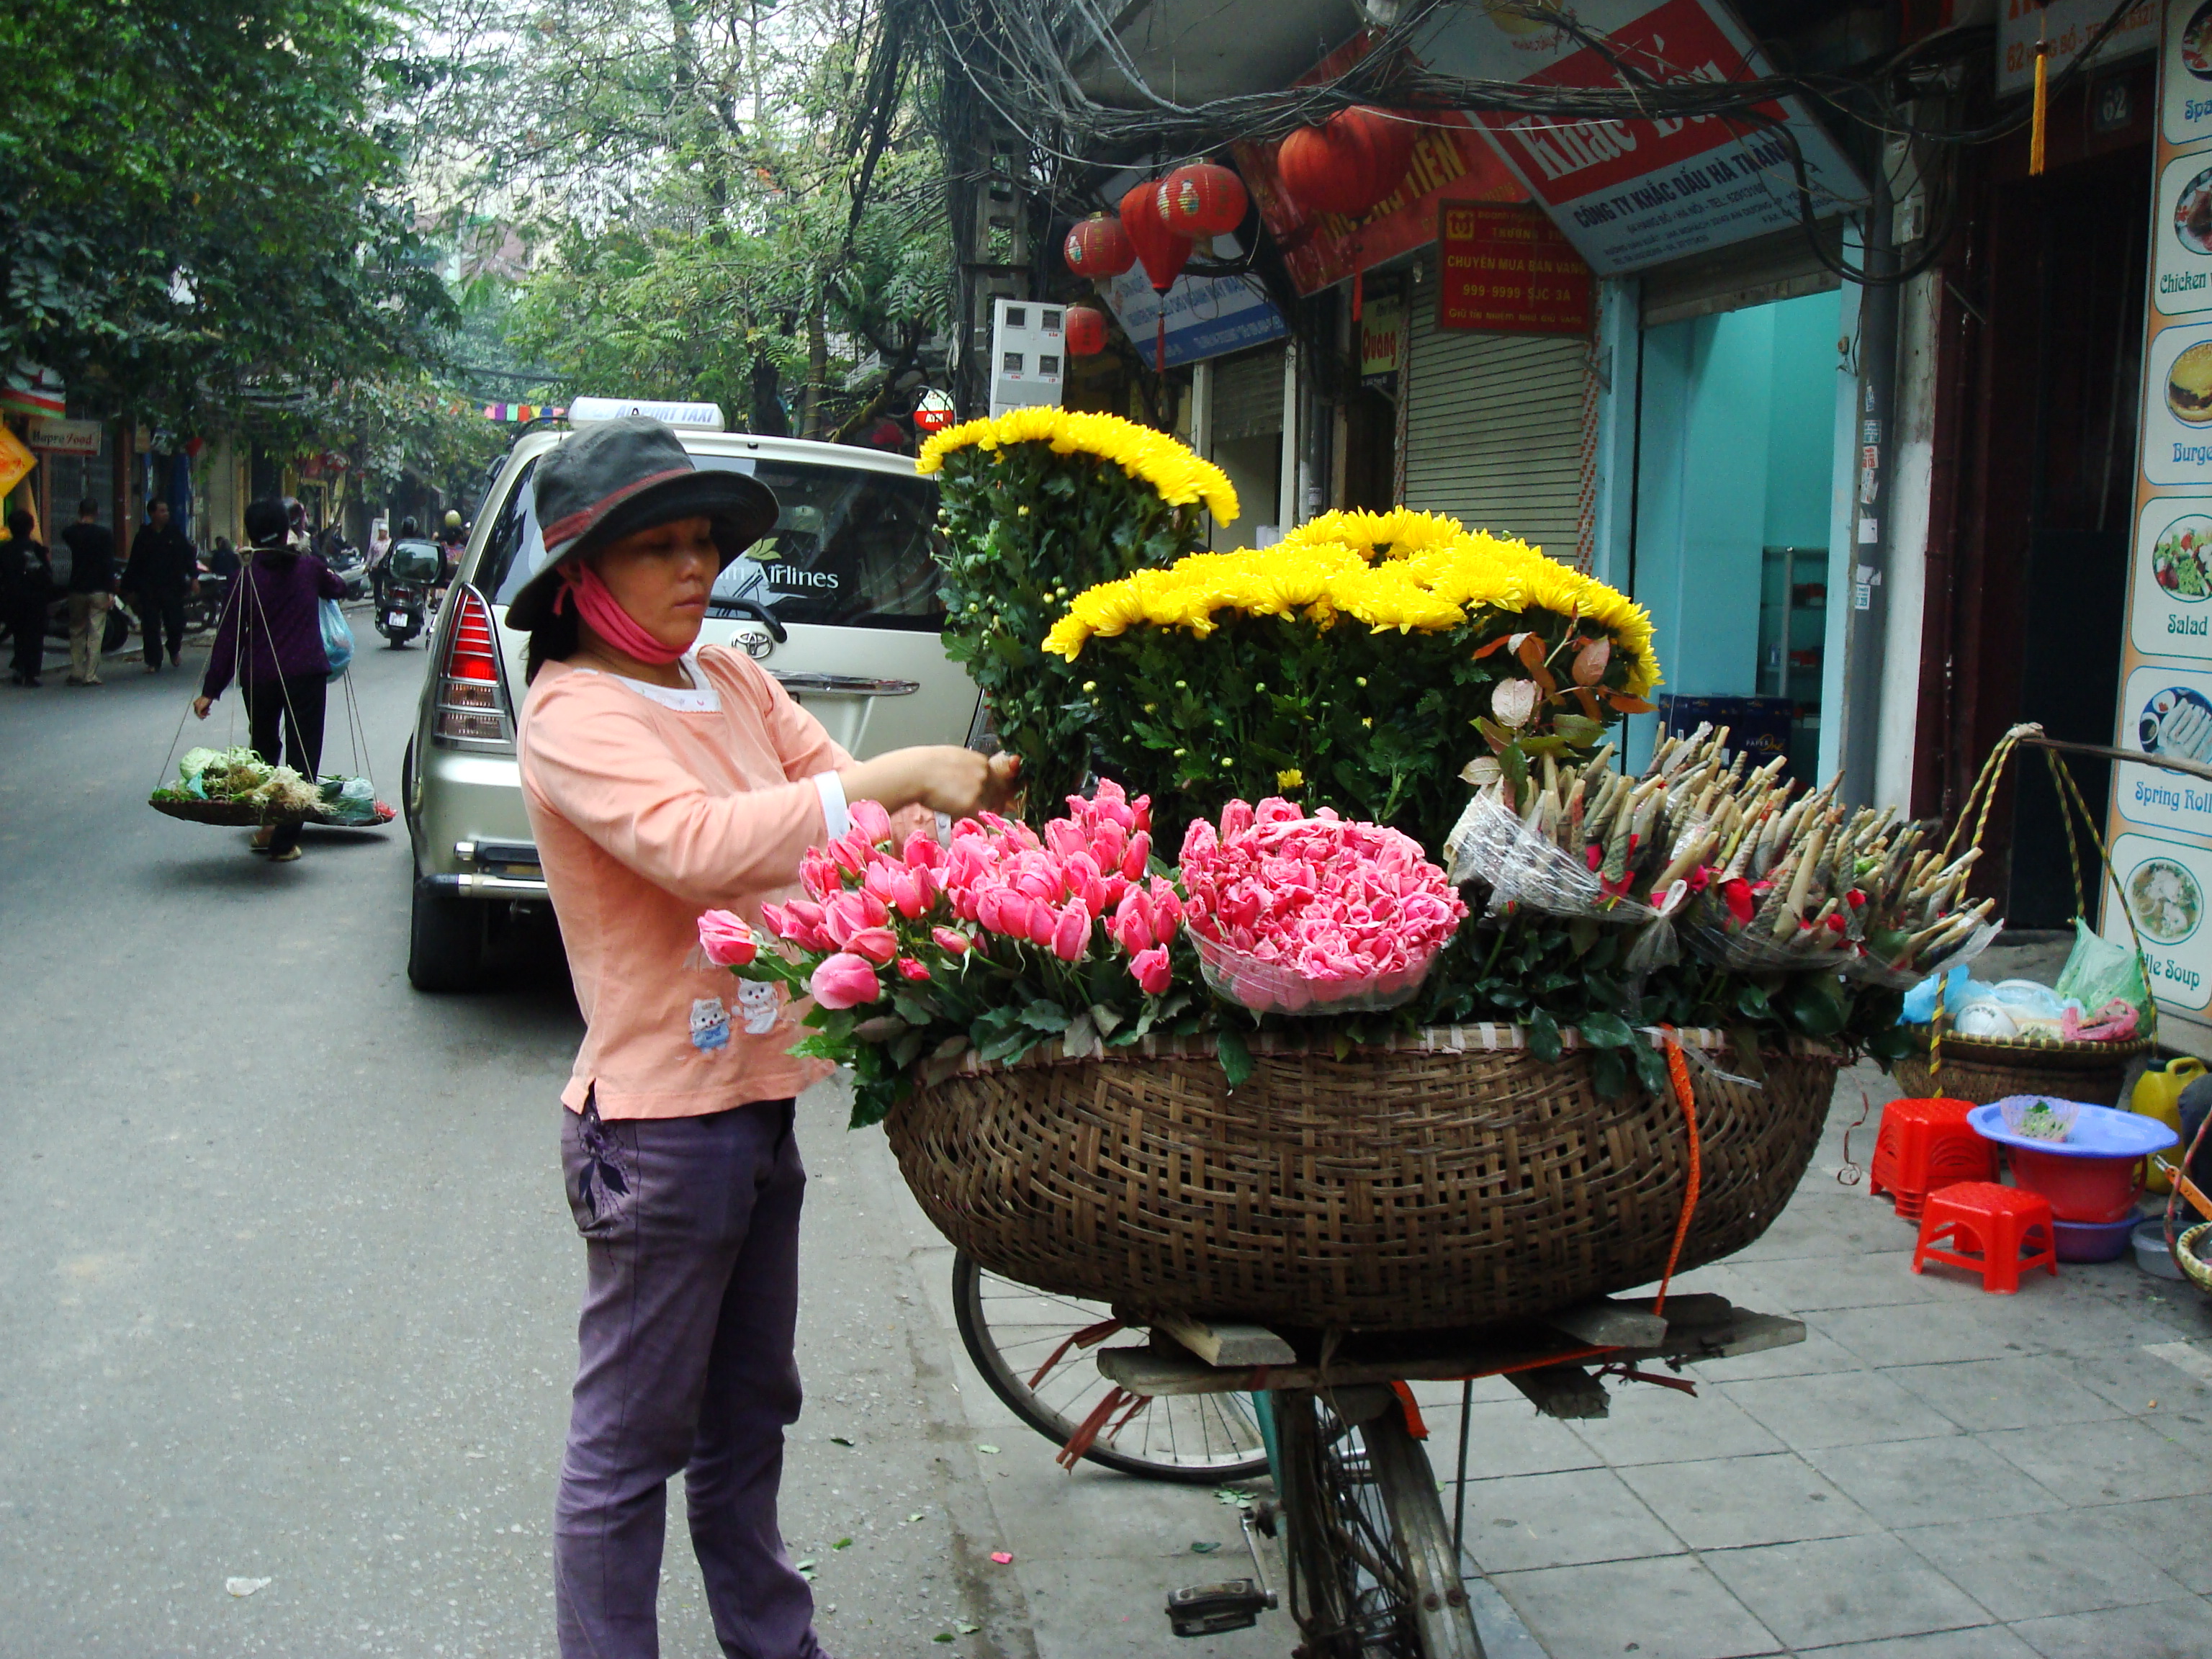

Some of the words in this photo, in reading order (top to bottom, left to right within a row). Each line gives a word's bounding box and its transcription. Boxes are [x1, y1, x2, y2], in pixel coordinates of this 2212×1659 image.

[2103, 86, 2126, 122] 62
[1573, 202, 1617, 228] CÔNG
[1611, 197, 1635, 217] TY
[1627, 179, 1677, 210] KHẮC
[1671, 166, 1712, 197] DẤU
[1706, 157, 1739, 185] HÀ
[1447, 254, 1495, 270] CHUYÊN
[1497, 258, 1526, 271] MUA
[2159, 271, 2206, 295] Chicken
[681, 408, 714, 423] TAXI
[752, 562, 840, 589] Airlines
[2167, 614, 2208, 637] Salad
[2135, 781, 2180, 811] Spring
[2165, 959, 2200, 991] Soup
